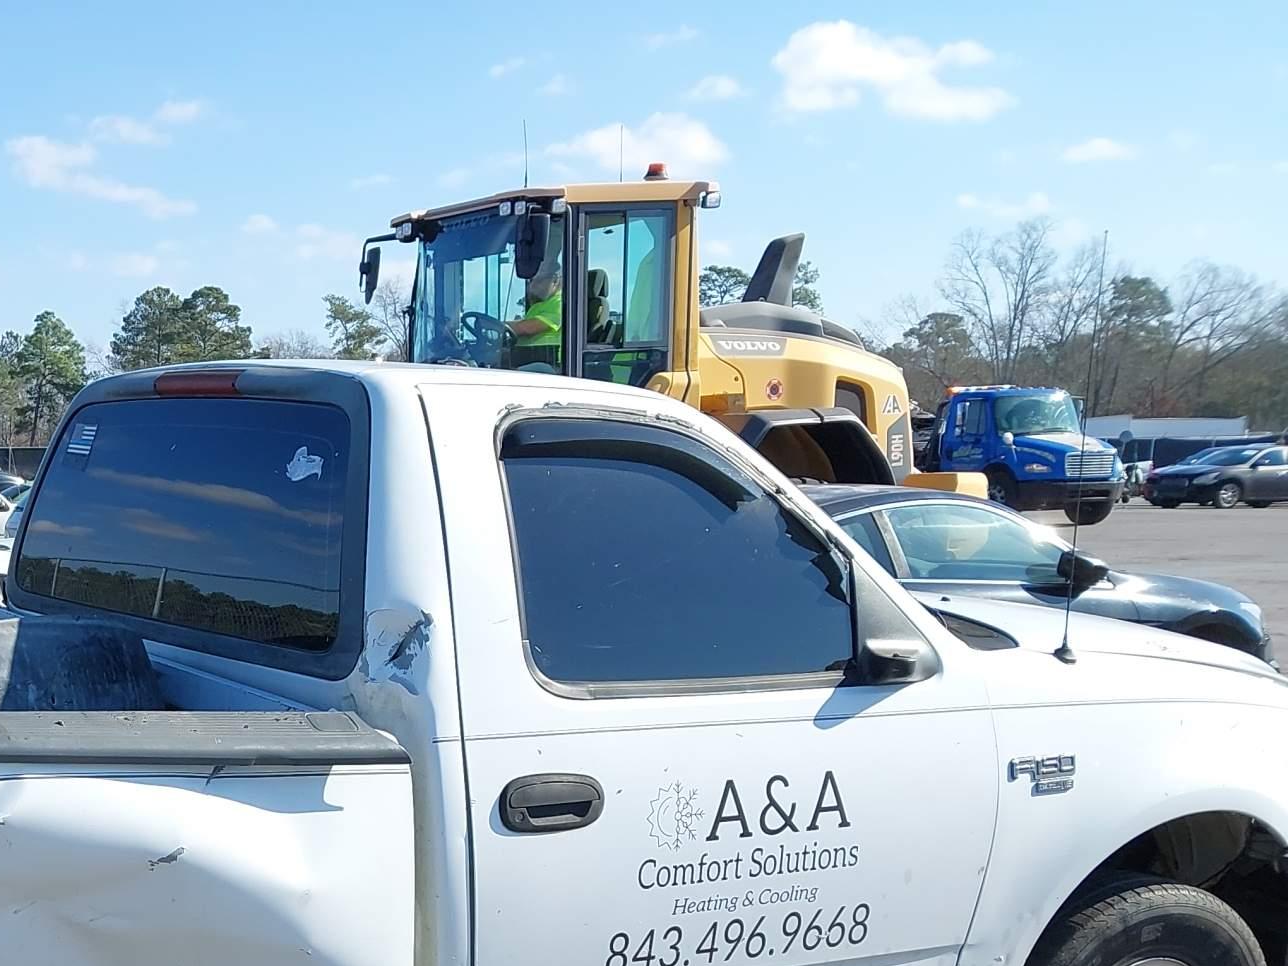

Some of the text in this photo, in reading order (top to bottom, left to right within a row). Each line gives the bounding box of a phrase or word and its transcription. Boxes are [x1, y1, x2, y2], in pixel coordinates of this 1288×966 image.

[717, 340, 781, 351] VOLVO
[891, 434, 904, 467] L90H
[705, 770, 852, 842] A&A
[637, 841, 859, 890] Comfort Solutions
[671, 885, 819, 916] Heating & Cooling
